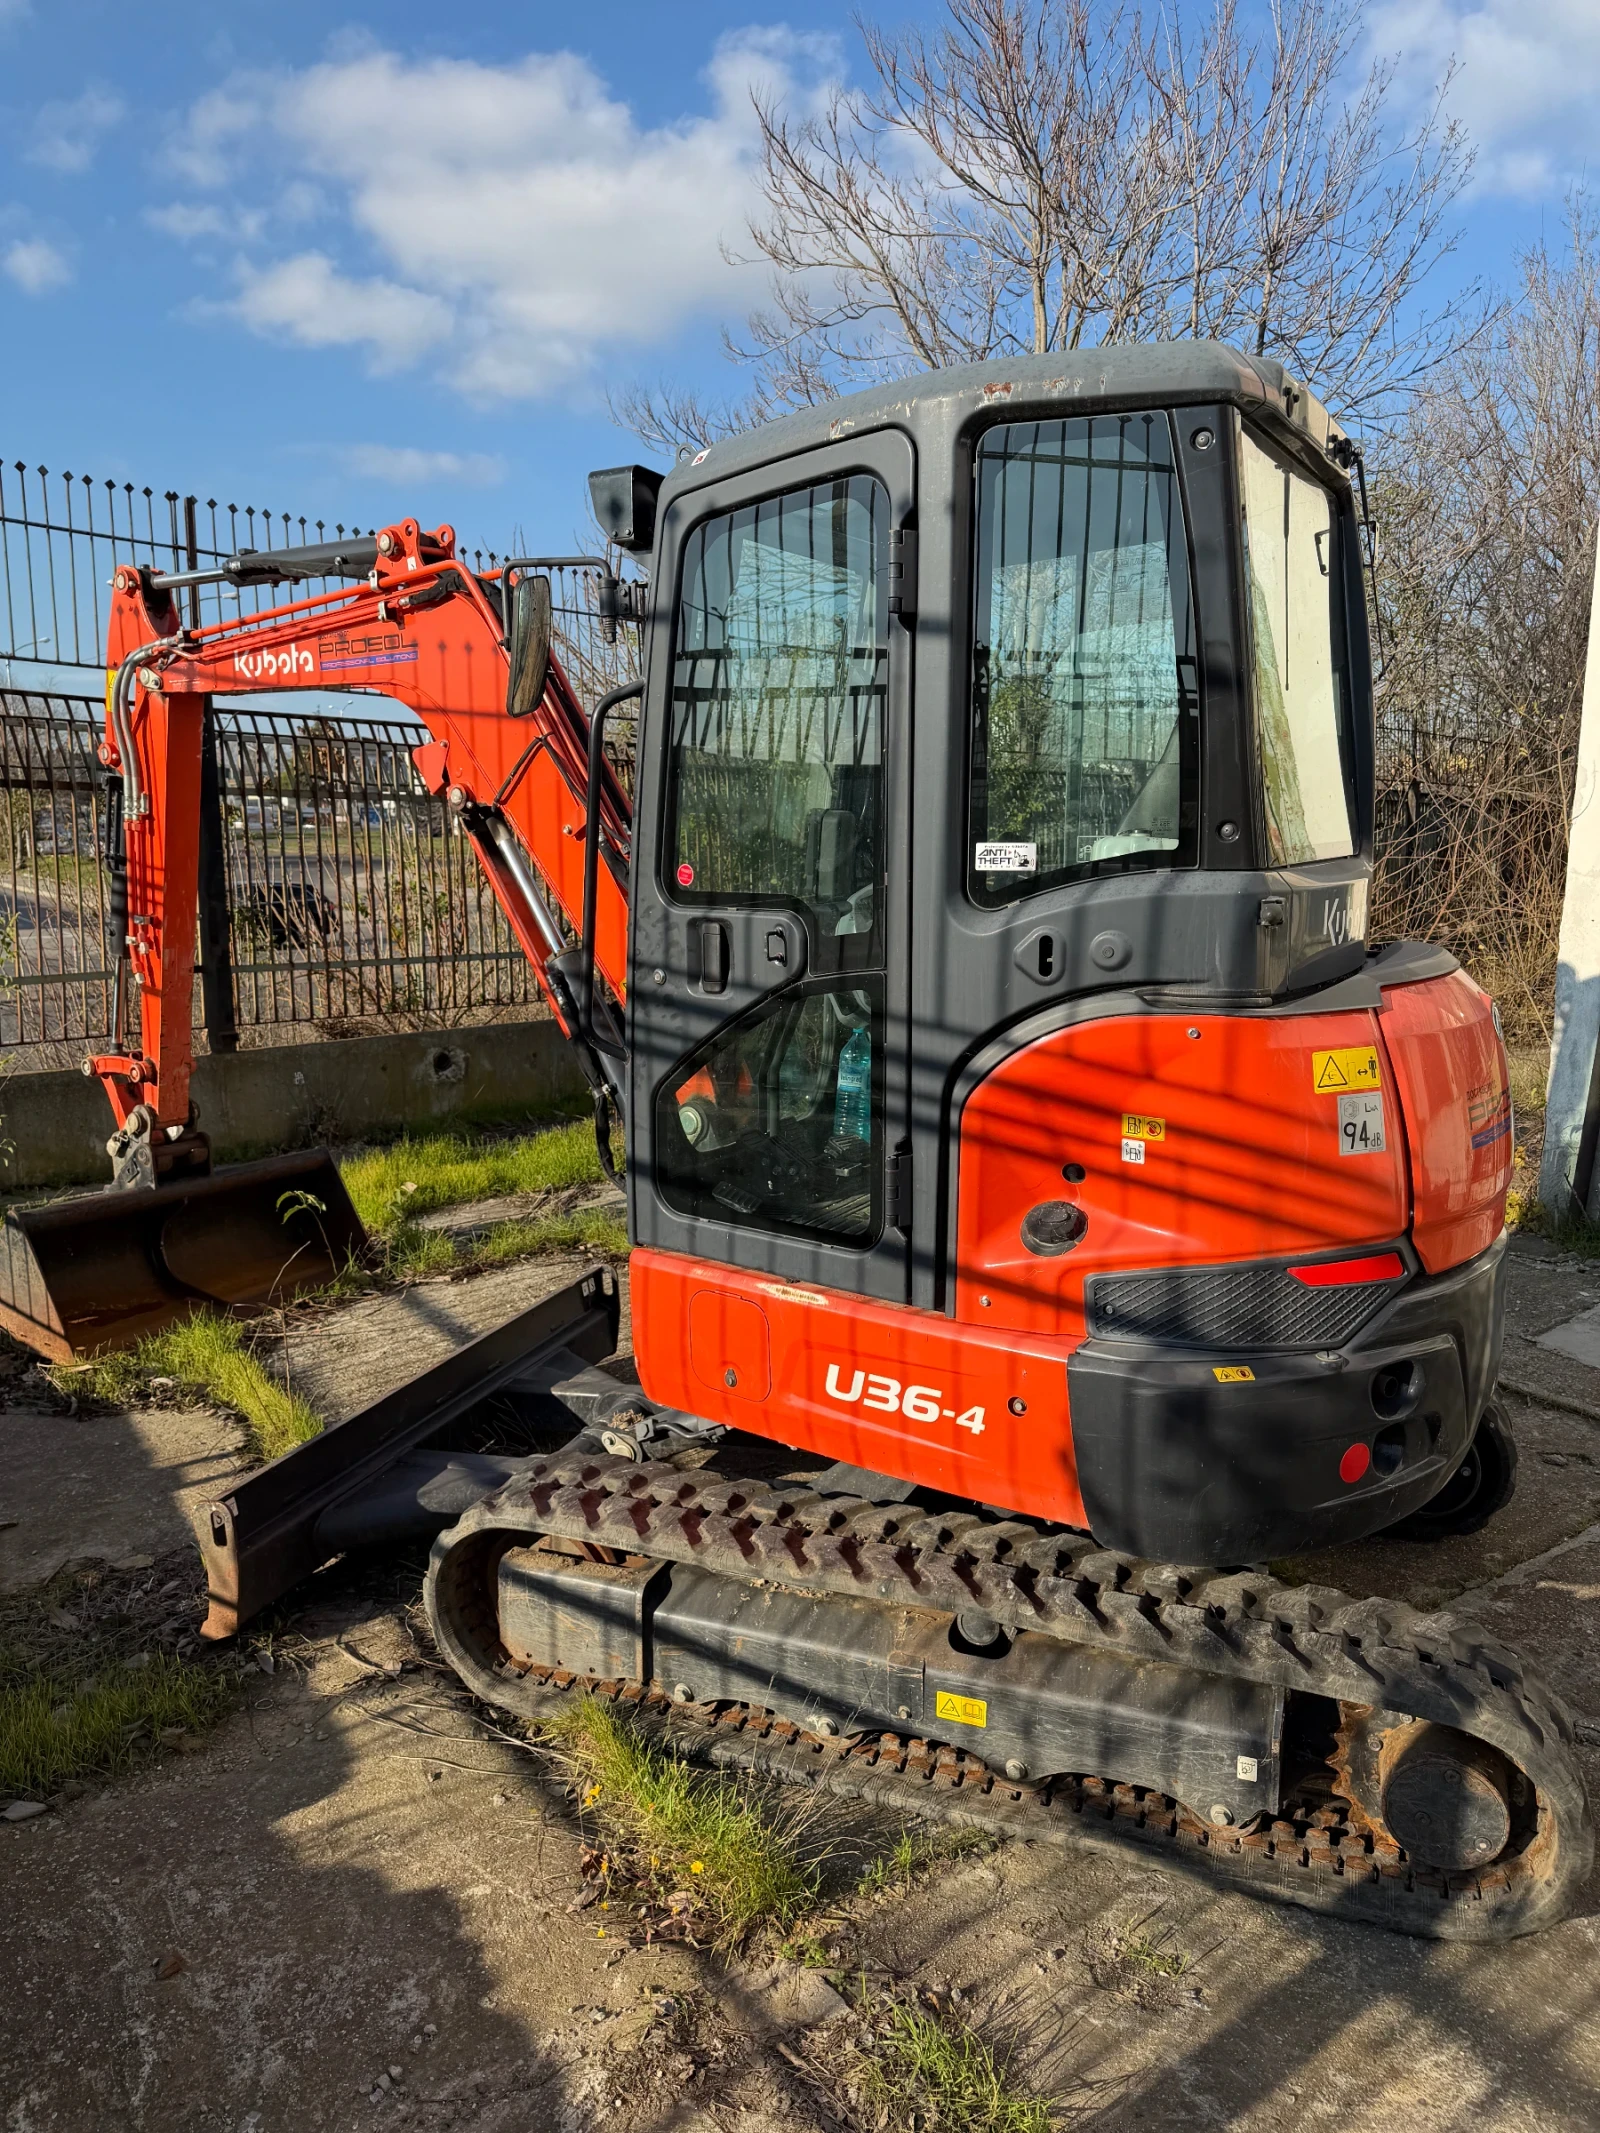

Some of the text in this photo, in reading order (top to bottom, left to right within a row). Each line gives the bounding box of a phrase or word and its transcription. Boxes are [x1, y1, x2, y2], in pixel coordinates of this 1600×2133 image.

[318, 634, 418, 659] PROSOL
[233, 643, 314, 677] Kubota
[321, 652, 417, 669] PROFESSIONAL SOLUTIONS
[977, 857, 1012, 865] THEFT
[825, 1363, 986, 1435] U36-4
